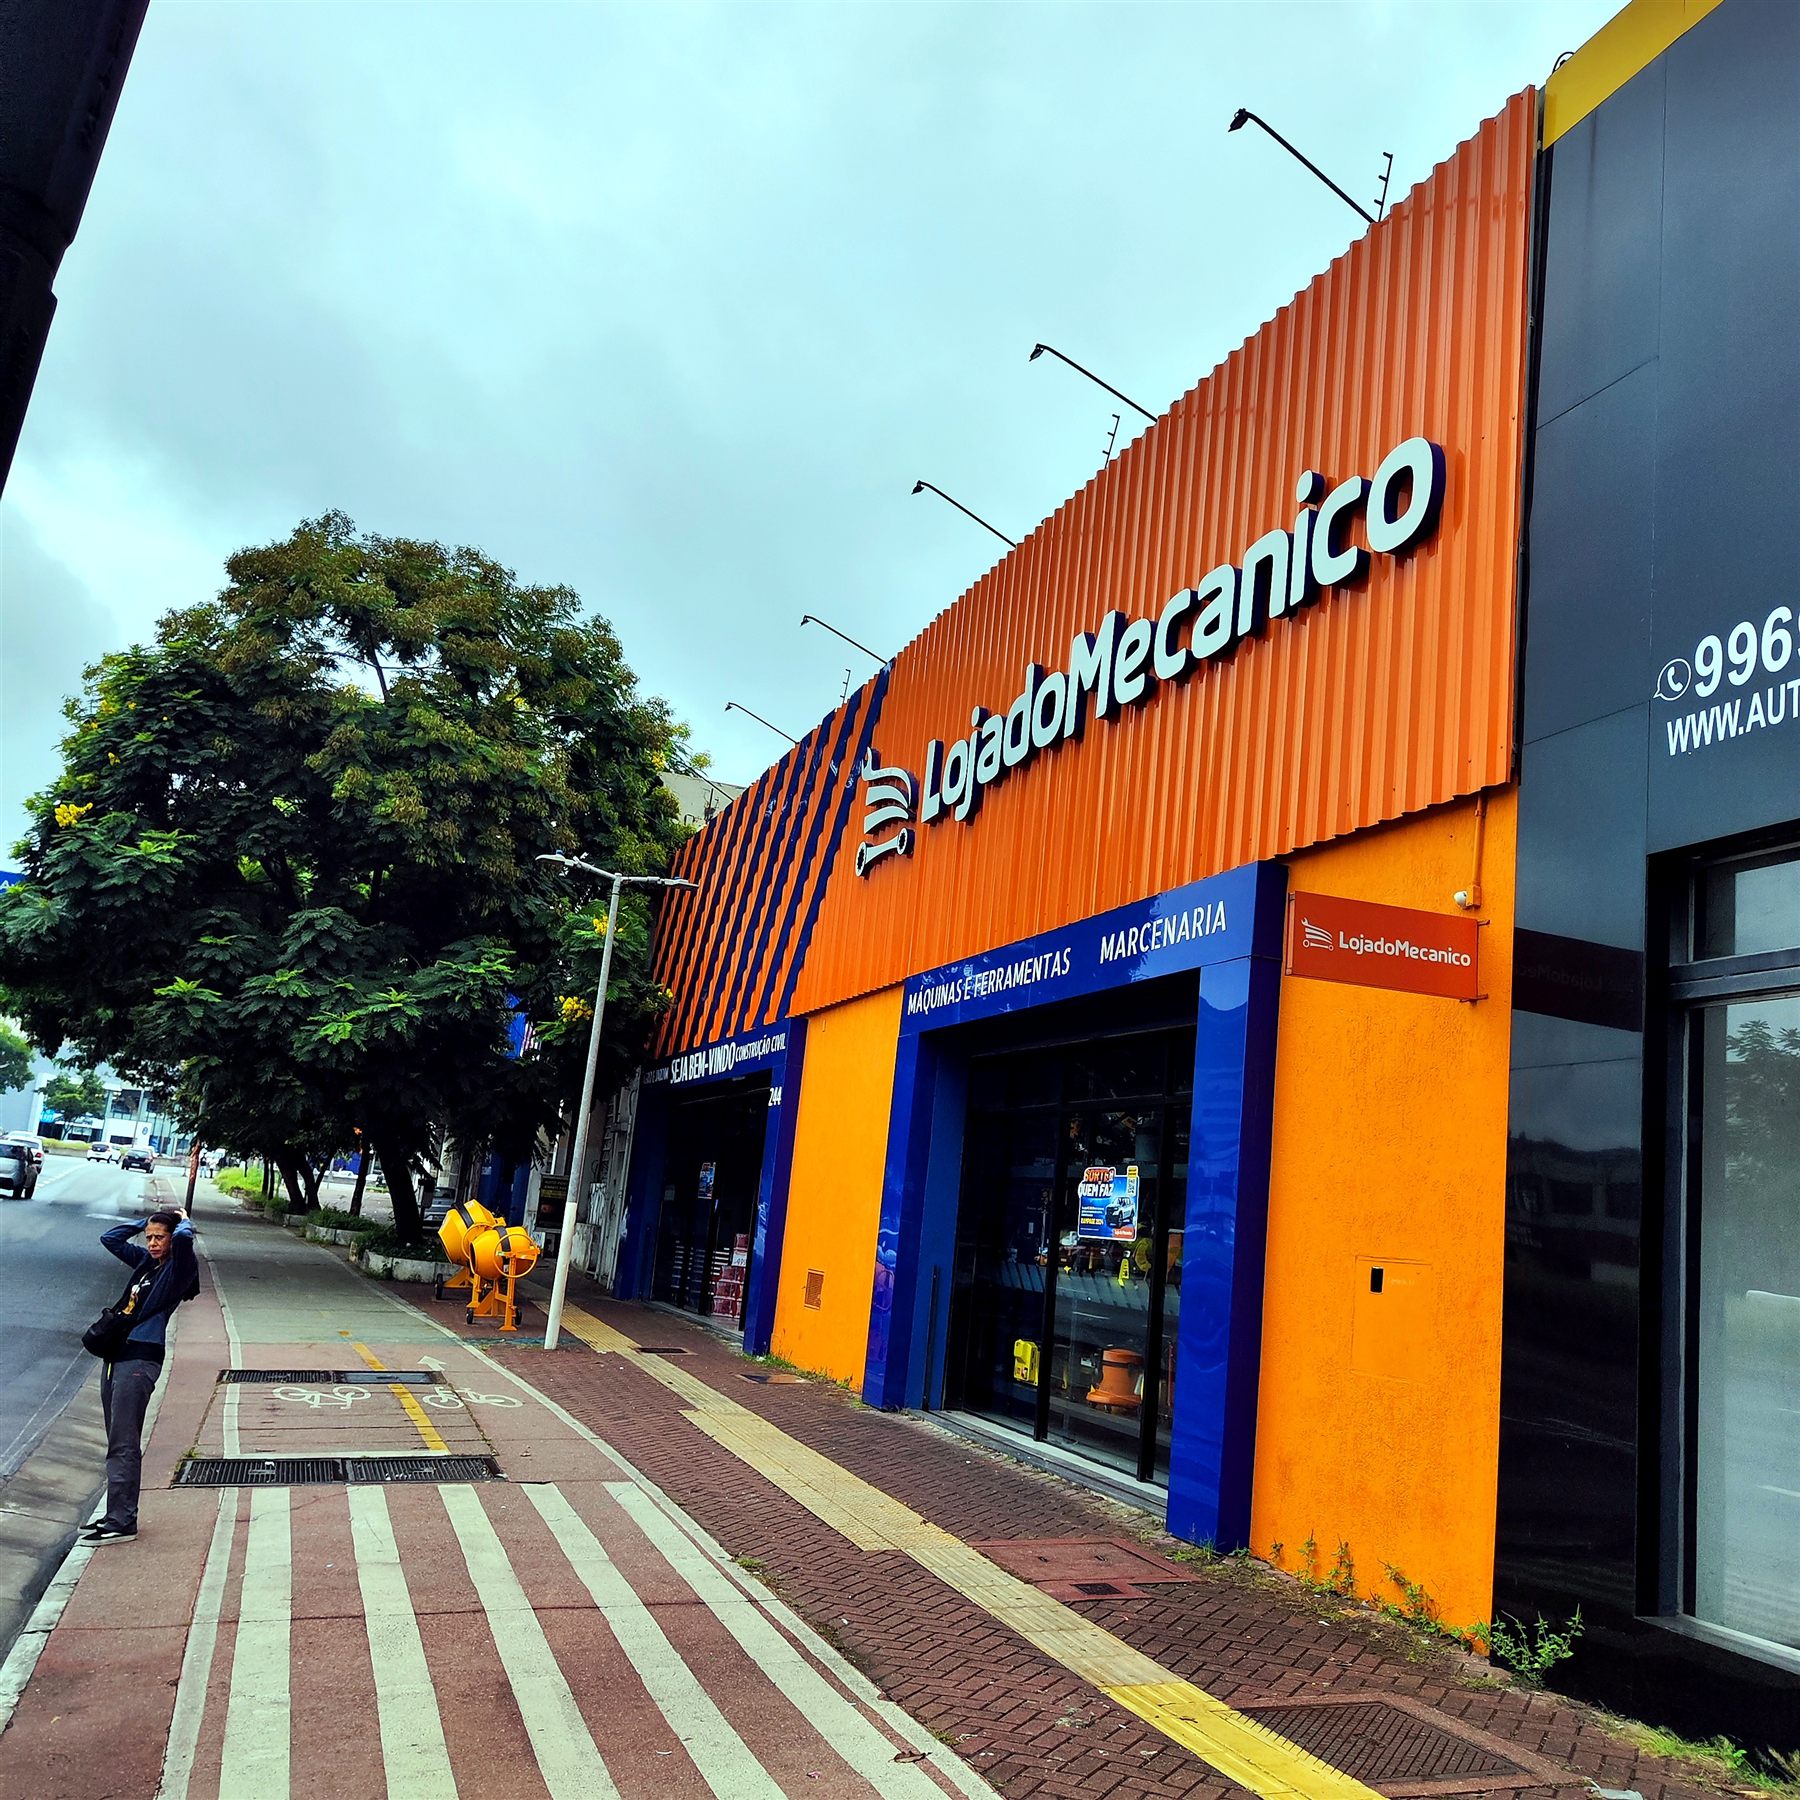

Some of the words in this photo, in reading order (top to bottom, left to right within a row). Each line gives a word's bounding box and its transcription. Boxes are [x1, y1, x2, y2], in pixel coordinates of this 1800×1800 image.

[921, 436, 1434, 823] LojadoMecanico
[1694, 606, 1800, 698] 996
[1099, 900, 1227, 964] MARCENARIA
[1339, 930, 1471, 967] LojadoMecanico
[907, 978, 962, 1016] MÁQUINAS
[963, 976, 973, 1001] E
[973, 947, 1071, 998] FERRAMENTAS
[670, 1056, 688, 1084] SEJA
[689, 1042, 736, 1080] BEM-VINDO
[735, 1034, 771, 1062] CONSTRUÇÃO
[771, 1033, 786, 1053] CIVIL
[768, 1086, 783, 1107] 244
[1078, 1183, 1099, 1198] QUEM
[1099, 1183, 1114, 1197] FAZ
